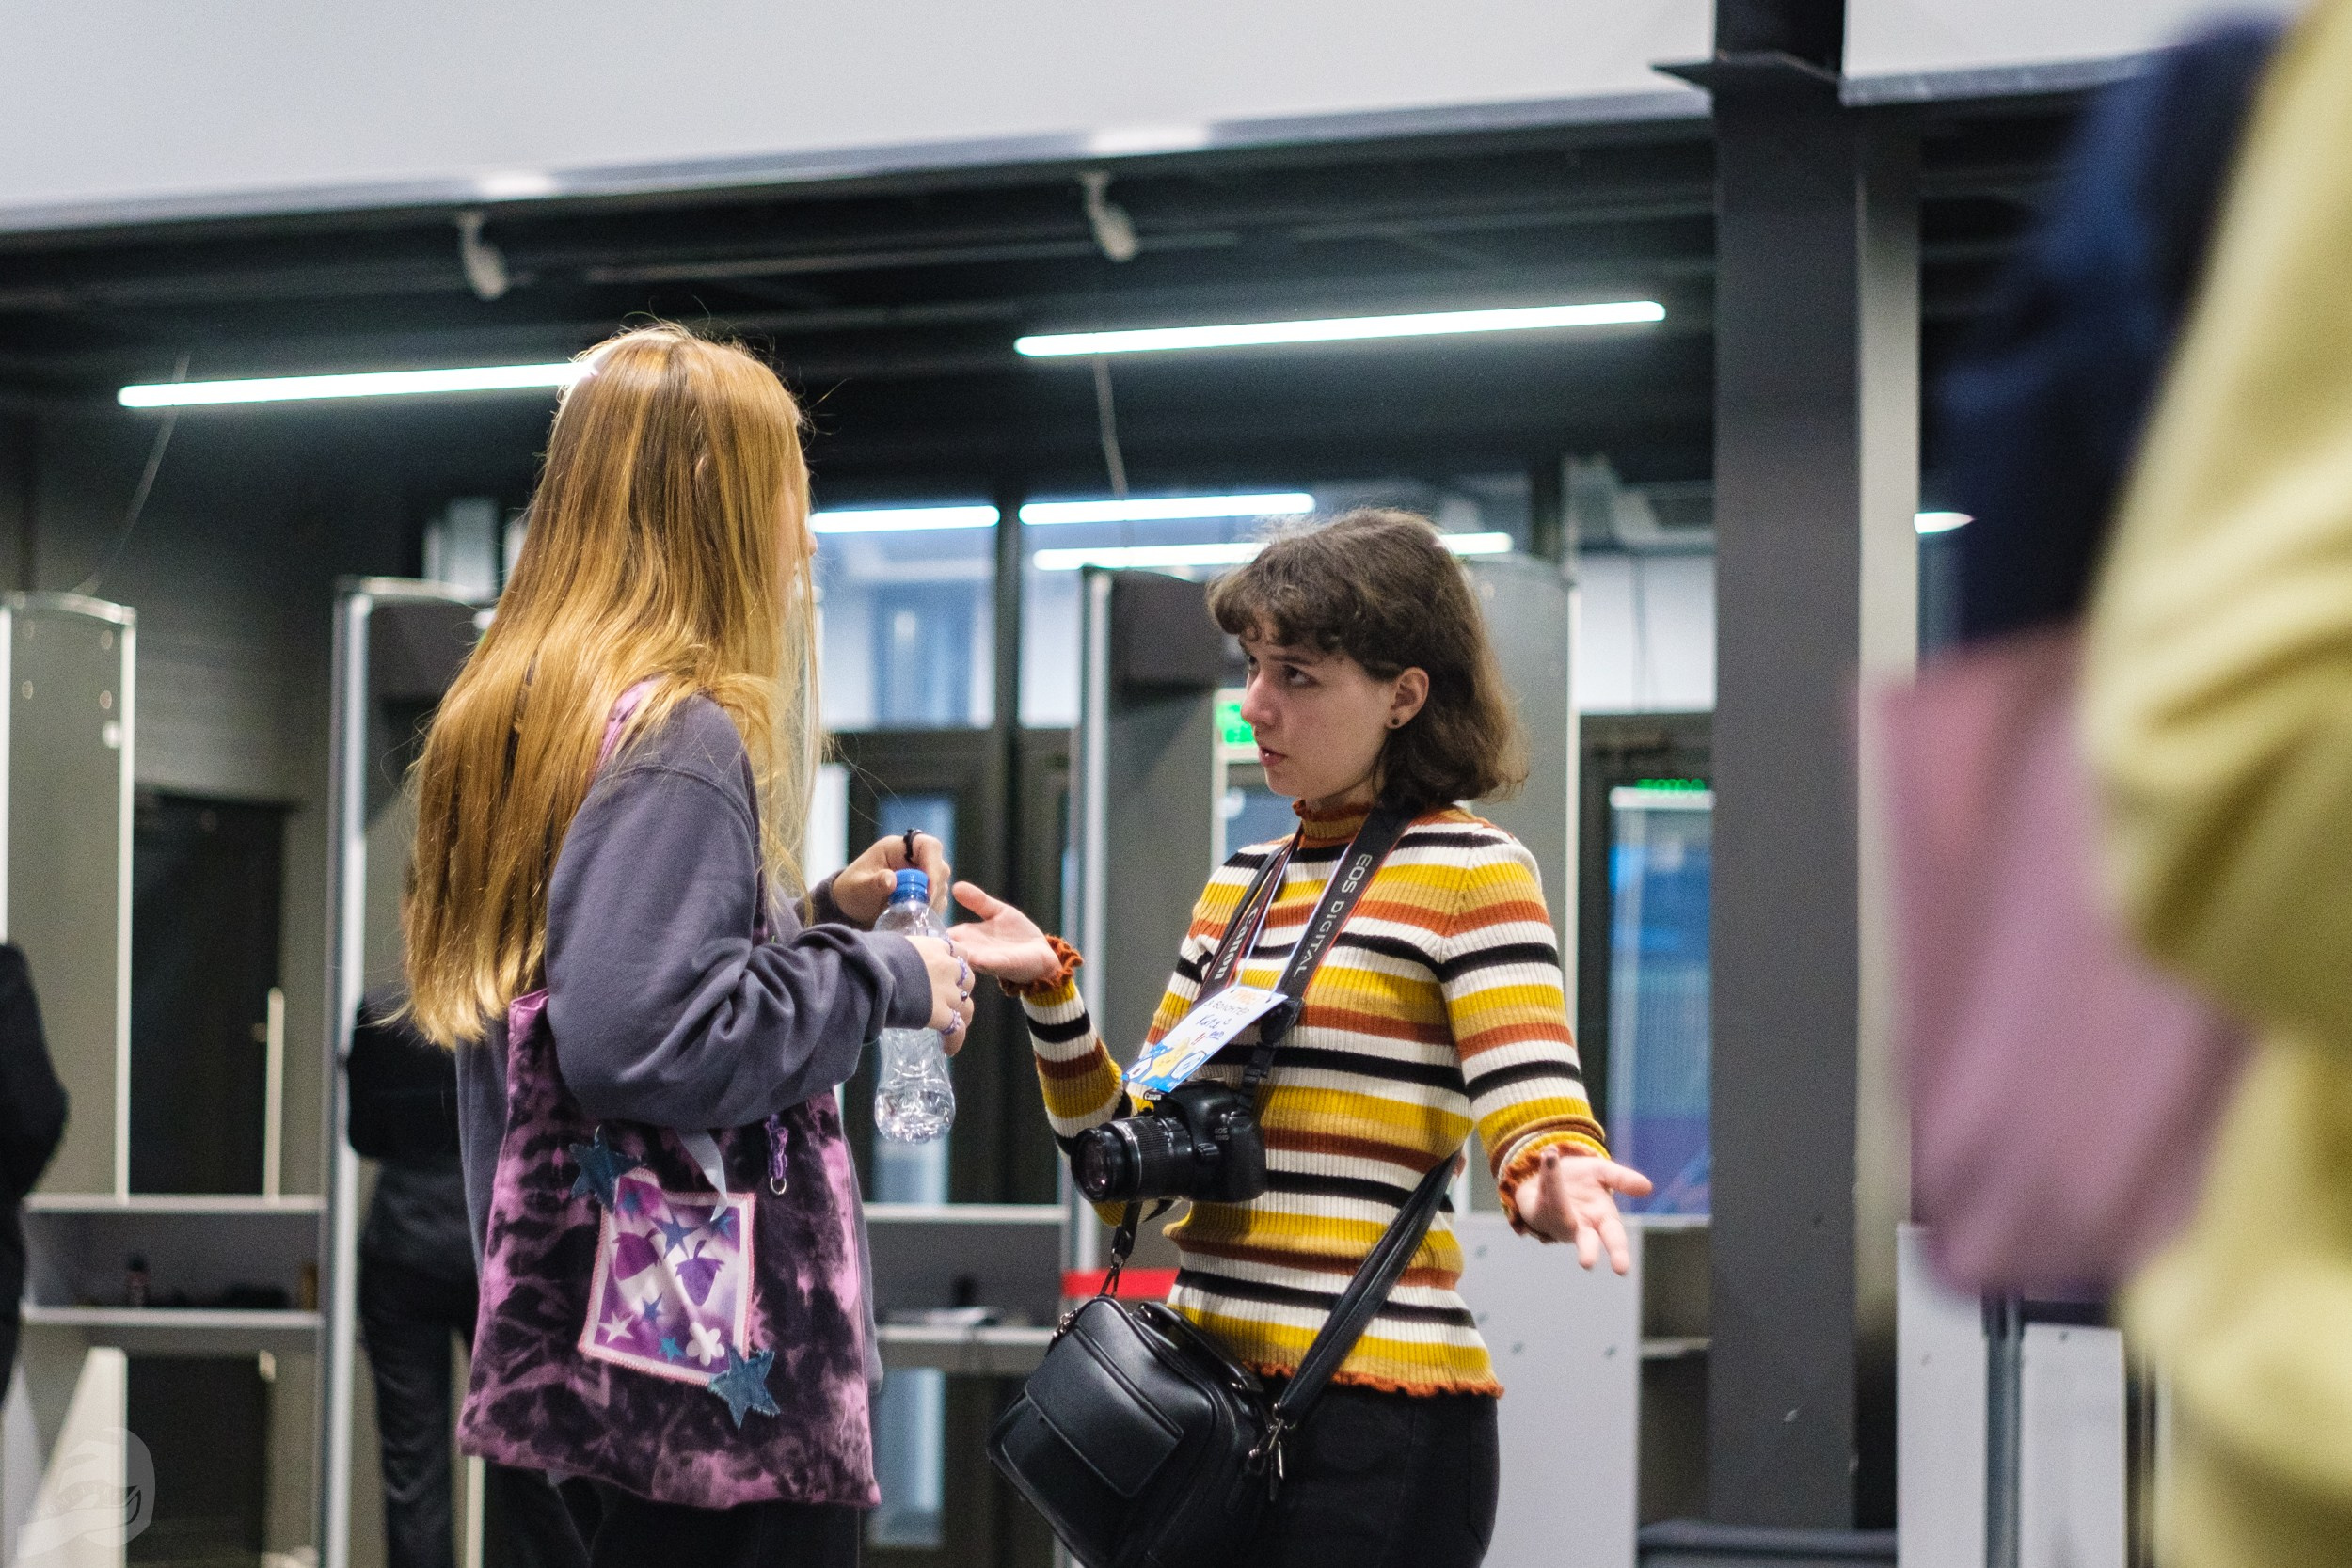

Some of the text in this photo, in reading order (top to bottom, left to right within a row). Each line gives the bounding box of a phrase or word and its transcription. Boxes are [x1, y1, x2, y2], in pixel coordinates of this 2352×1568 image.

[1214, 907, 1259, 980] Canon
[1294, 853, 1373, 977] EOS DIGITAL
